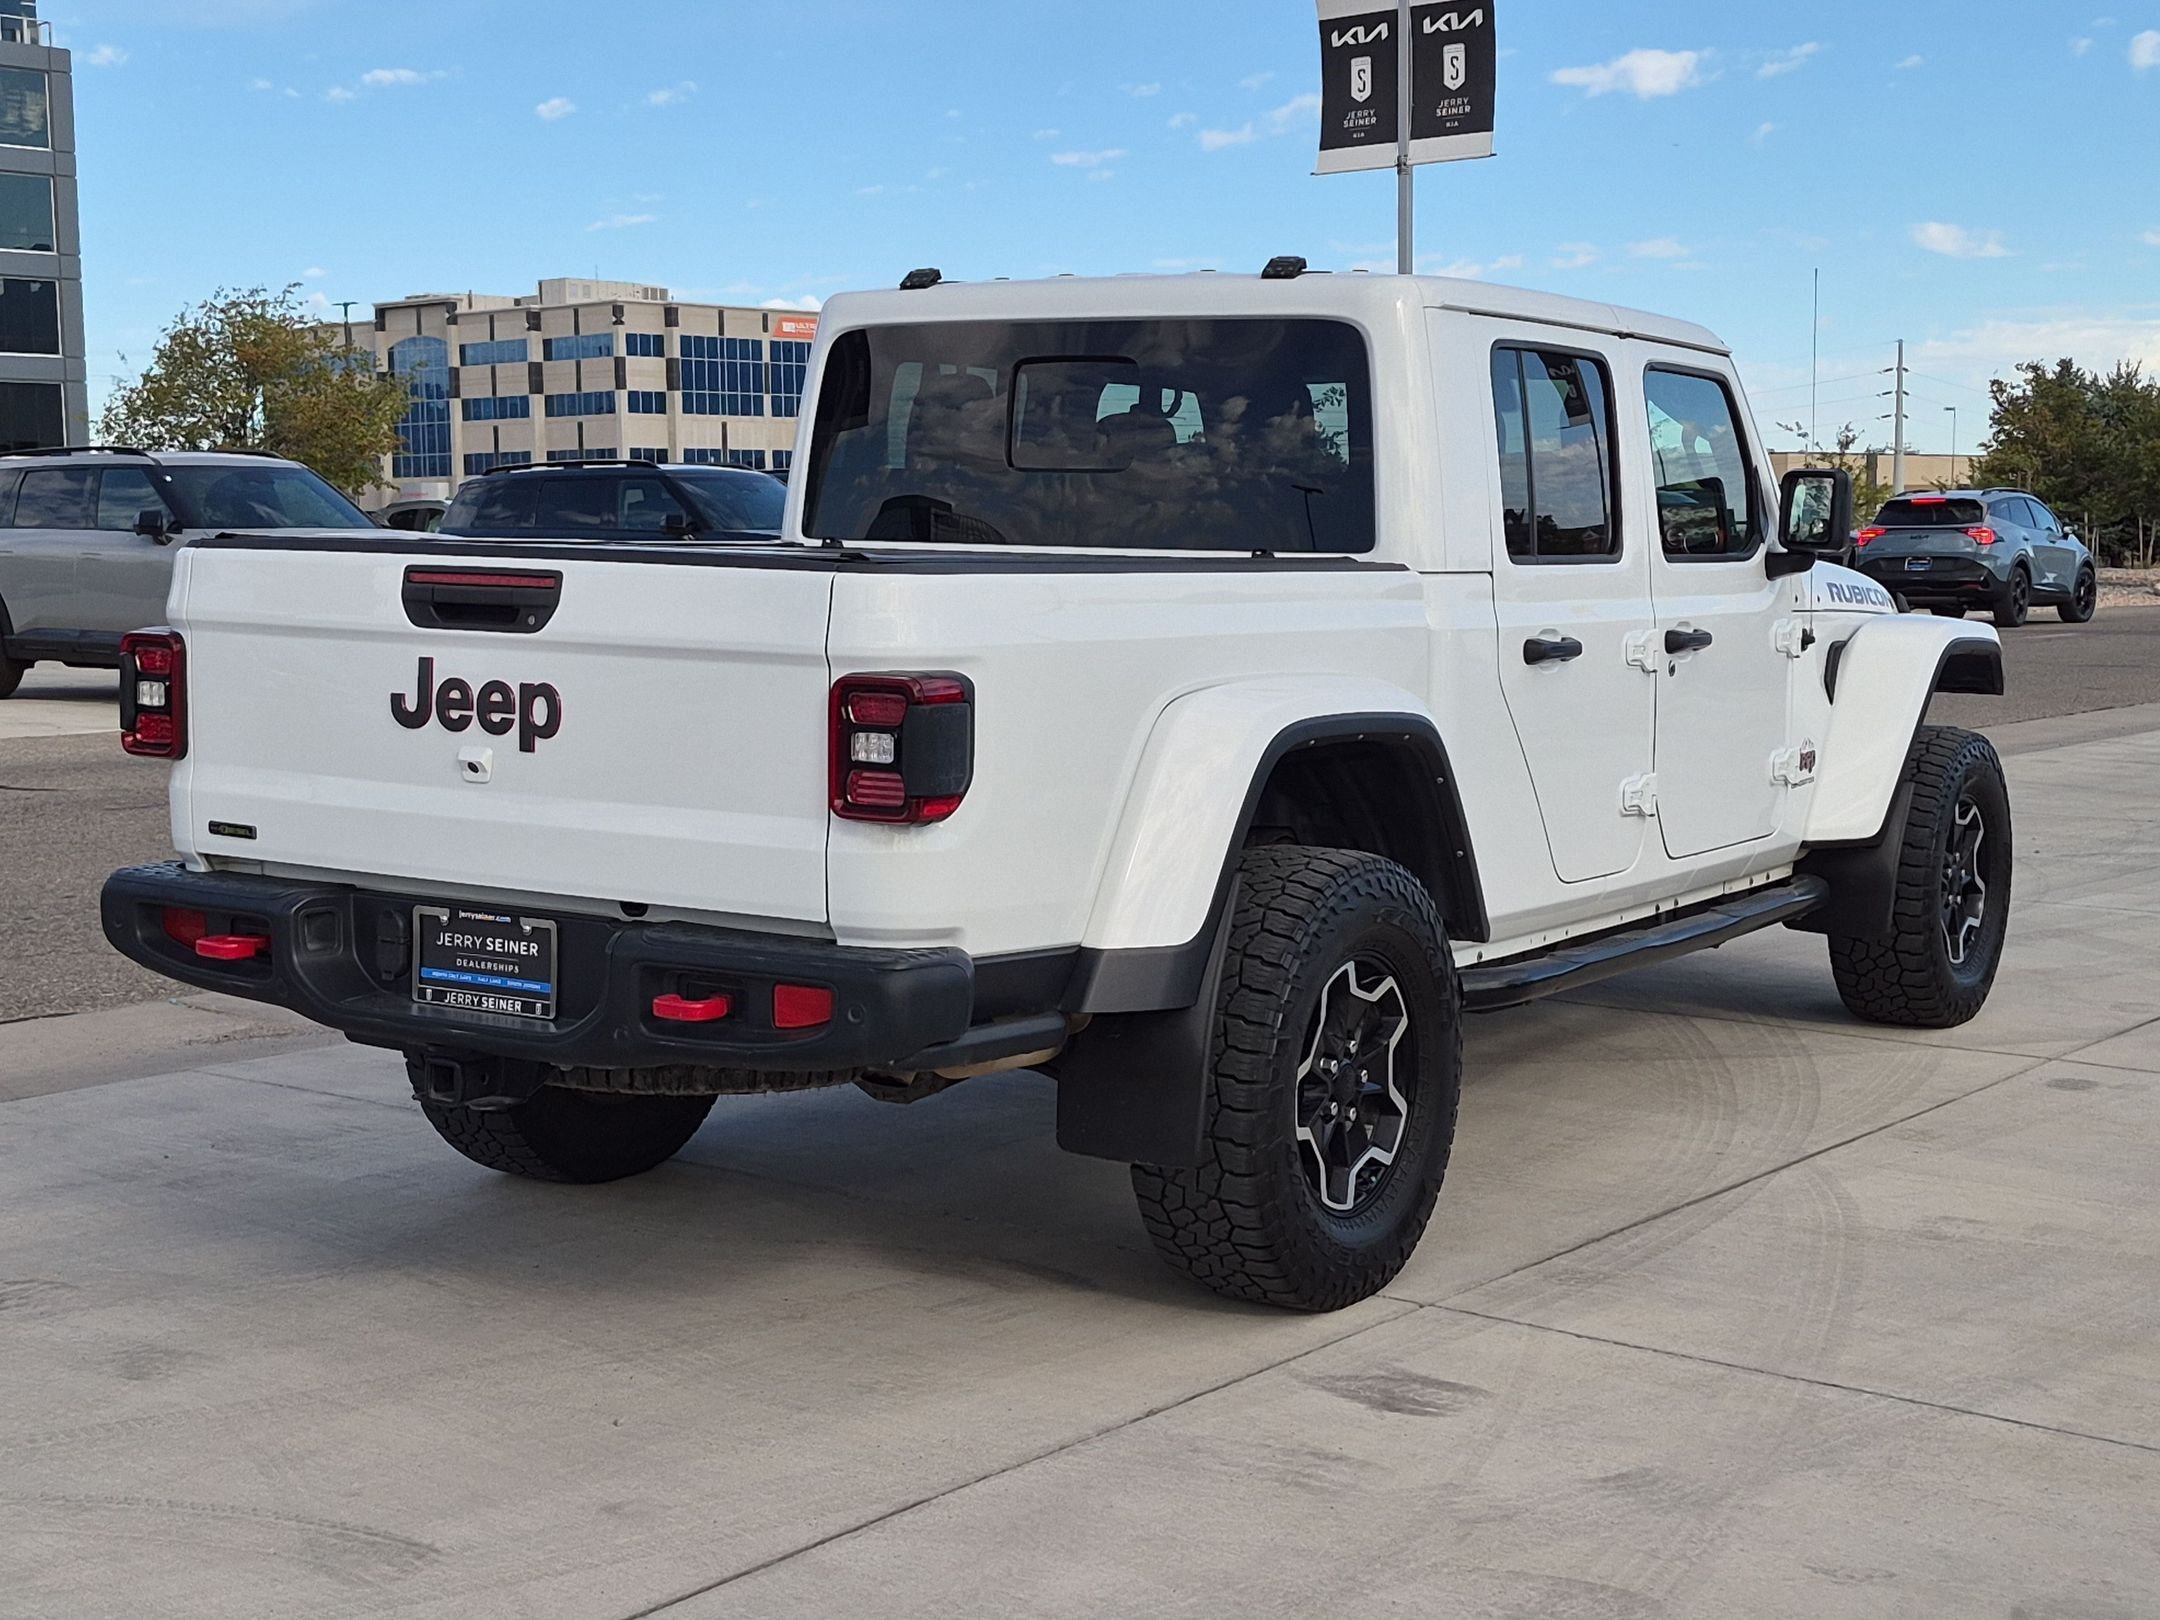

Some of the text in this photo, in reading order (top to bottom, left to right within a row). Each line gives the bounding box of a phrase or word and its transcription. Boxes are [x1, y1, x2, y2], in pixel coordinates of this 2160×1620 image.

[1438, 96, 1469, 108] JERRY
[1346, 108, 1375, 120] JERRY
[1436, 105, 1471, 117] SEINER
[1343, 116, 1377, 128] SEINER
[1826, 582, 1895, 610] RUBICON
[390, 656, 562, 753] Jeep
[436, 931, 539, 957] JERRY SEINER
[456, 958, 519, 974] DEALERSHIPS
[444, 992, 522, 1012] JERRY SEINER
